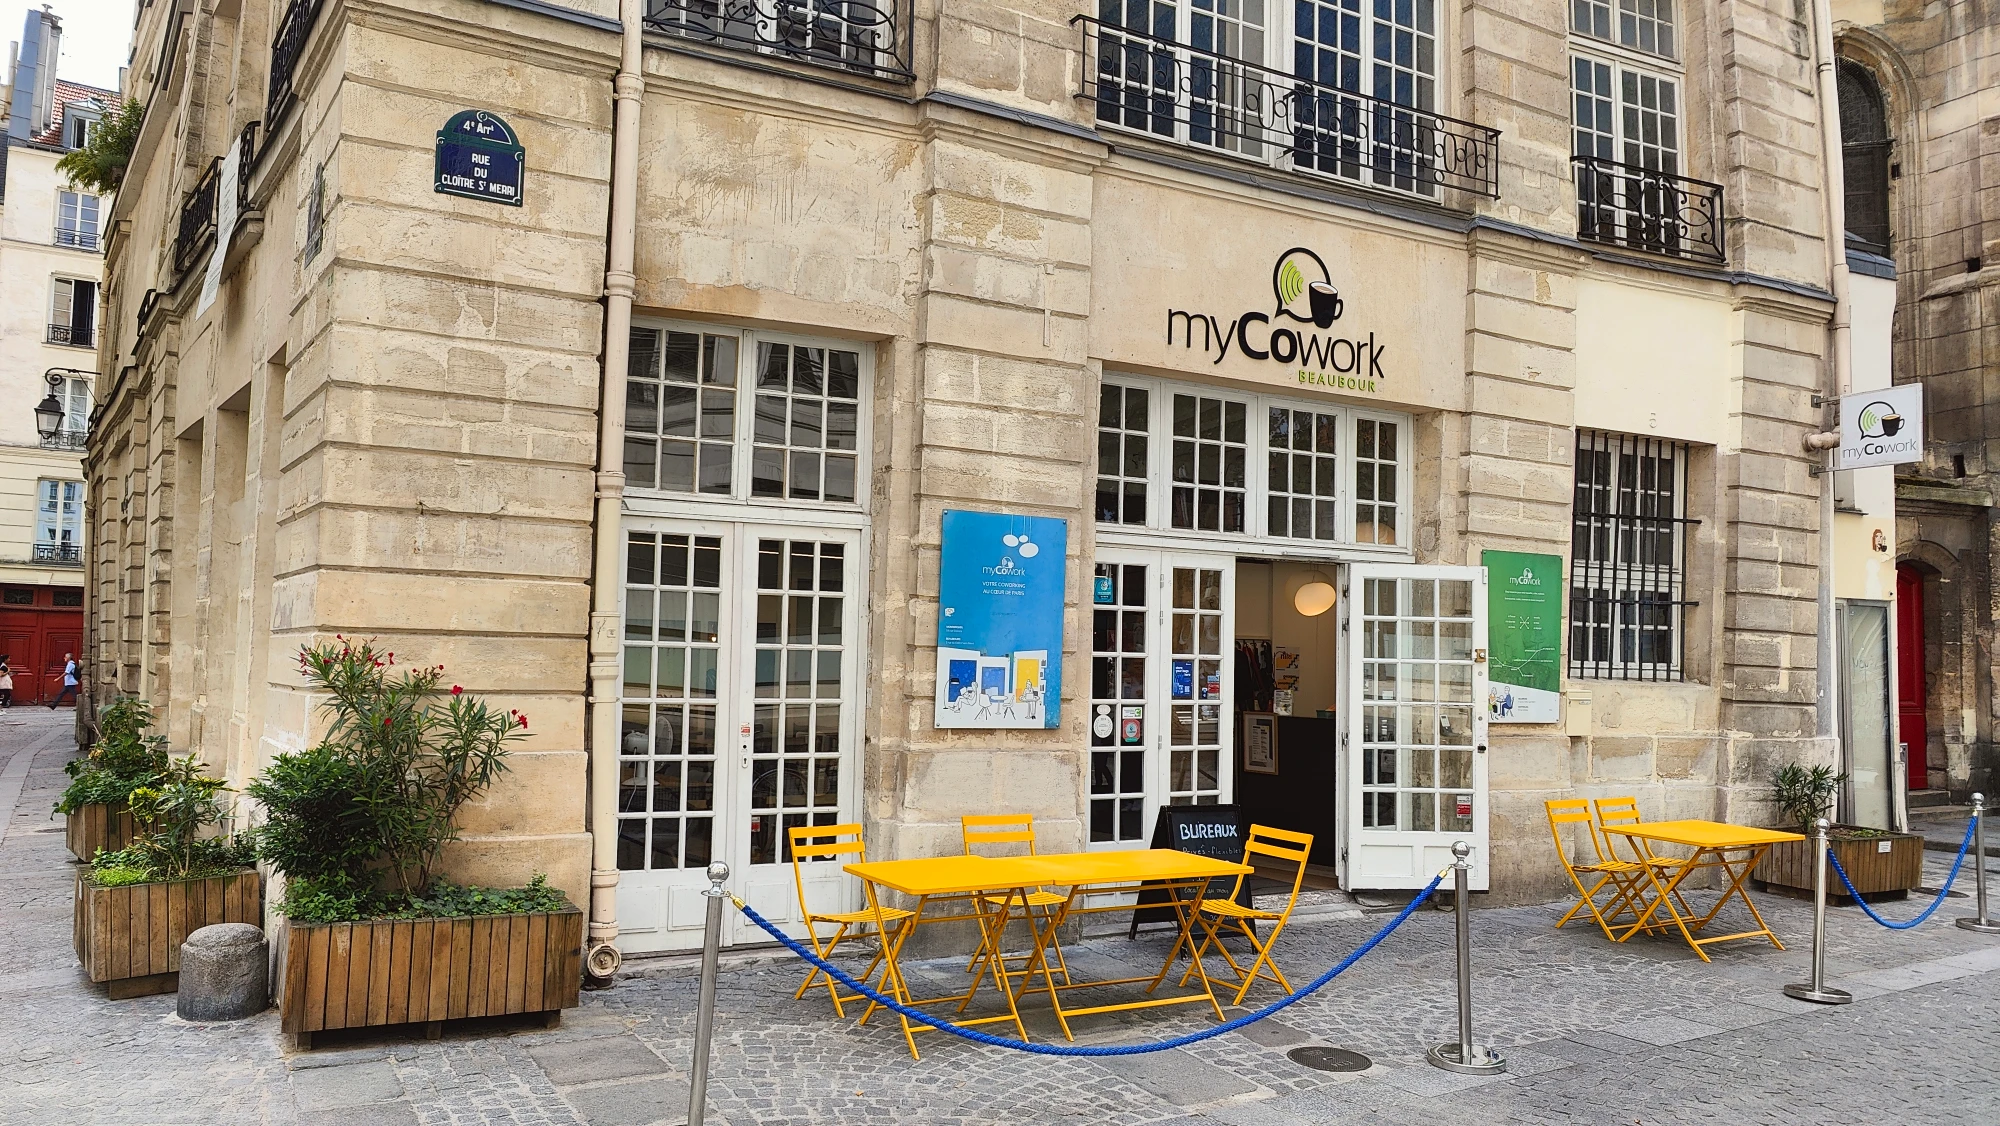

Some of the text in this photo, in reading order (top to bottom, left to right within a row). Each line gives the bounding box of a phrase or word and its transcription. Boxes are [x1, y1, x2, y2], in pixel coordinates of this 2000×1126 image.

[471, 153, 491, 166] RUE
[474, 167, 488, 178] DU
[441, 174, 515, 196] CLOÎTRE St MERRI
[1167, 308, 1385, 379] myCowork
[1842, 439, 1917, 460] myCowork
[982, 565, 1026, 577] myCowork
[1509, 576, 1541, 586] myCowork
[1180, 823, 1238, 840] BUREAUX
